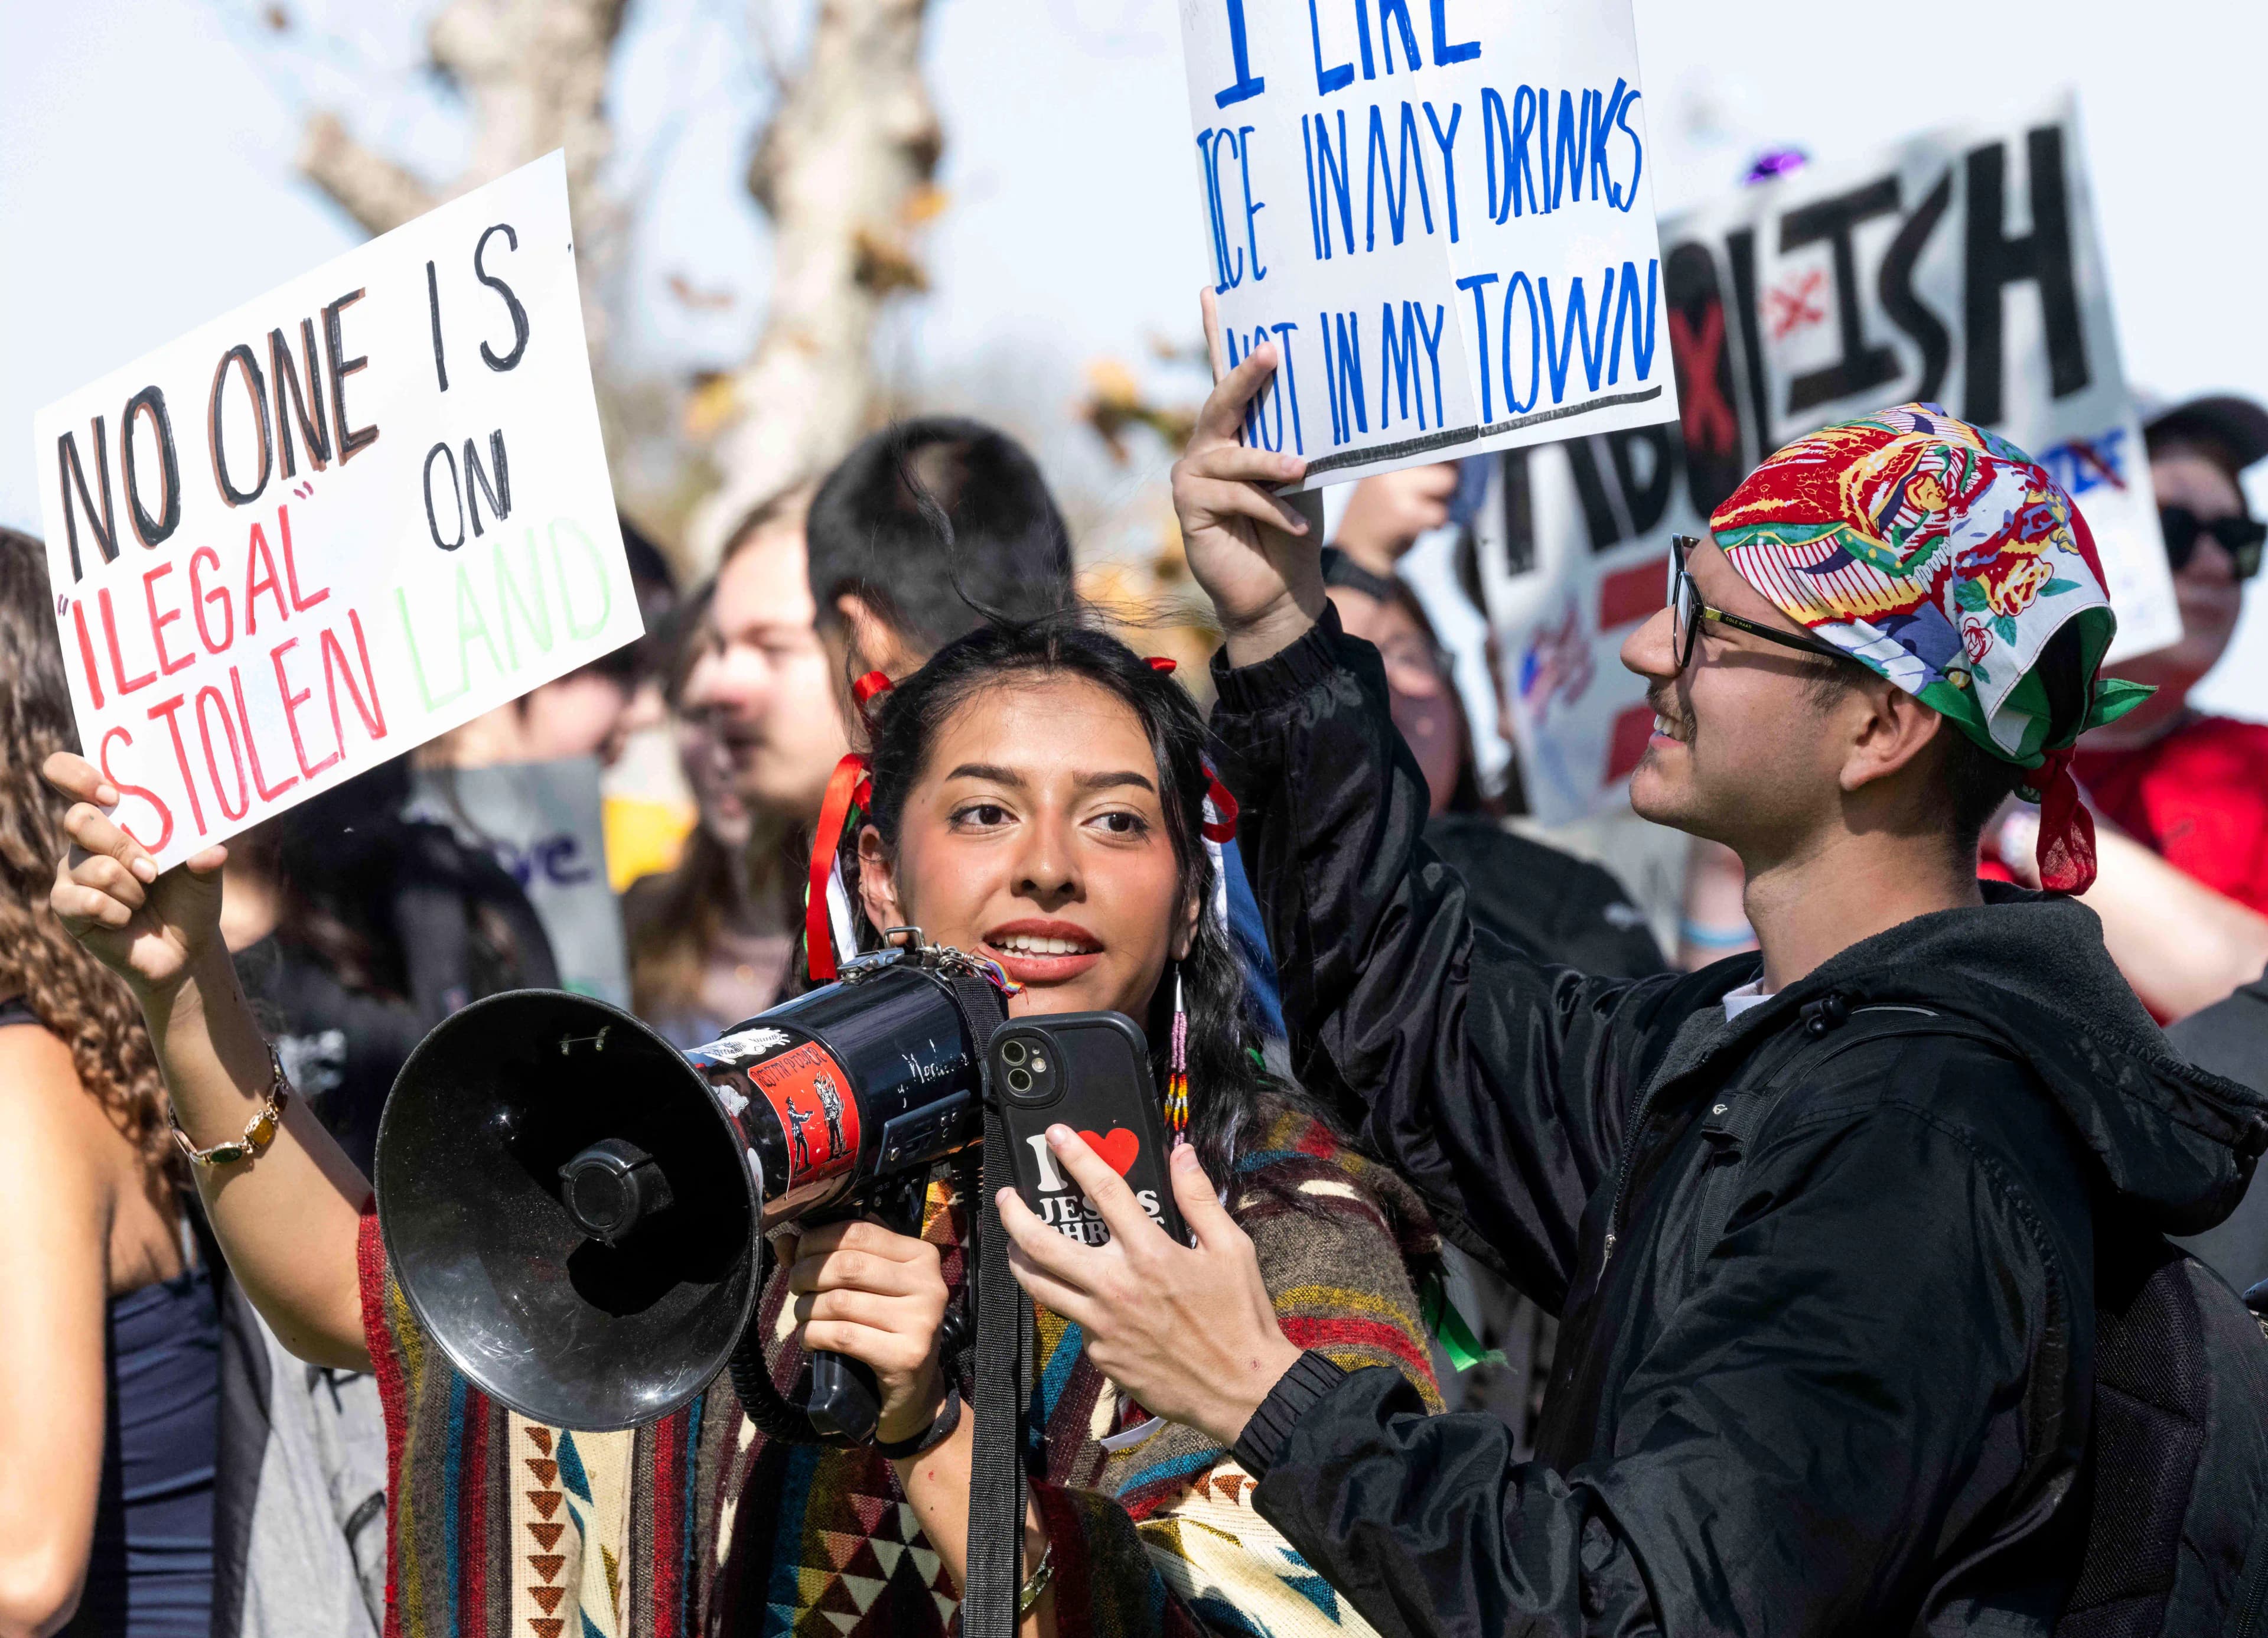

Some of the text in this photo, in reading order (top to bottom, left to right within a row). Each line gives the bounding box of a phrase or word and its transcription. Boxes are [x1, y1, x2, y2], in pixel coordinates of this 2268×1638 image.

[1215, 0, 1265, 109] I
[1197, 77, 1642, 295] ICE IN MY DRINKS
[58, 223, 530, 584] NO ONE IS
[1227, 259, 1658, 455] NOT IN MY TOWN
[423, 428, 511, 551] ON
[102, 516, 611, 855] STOLEN LAND
[750, 1066, 780, 1087] REST
[1026, 1134, 1068, 1192] I
[1037, 1190, 1160, 1225] JESS
